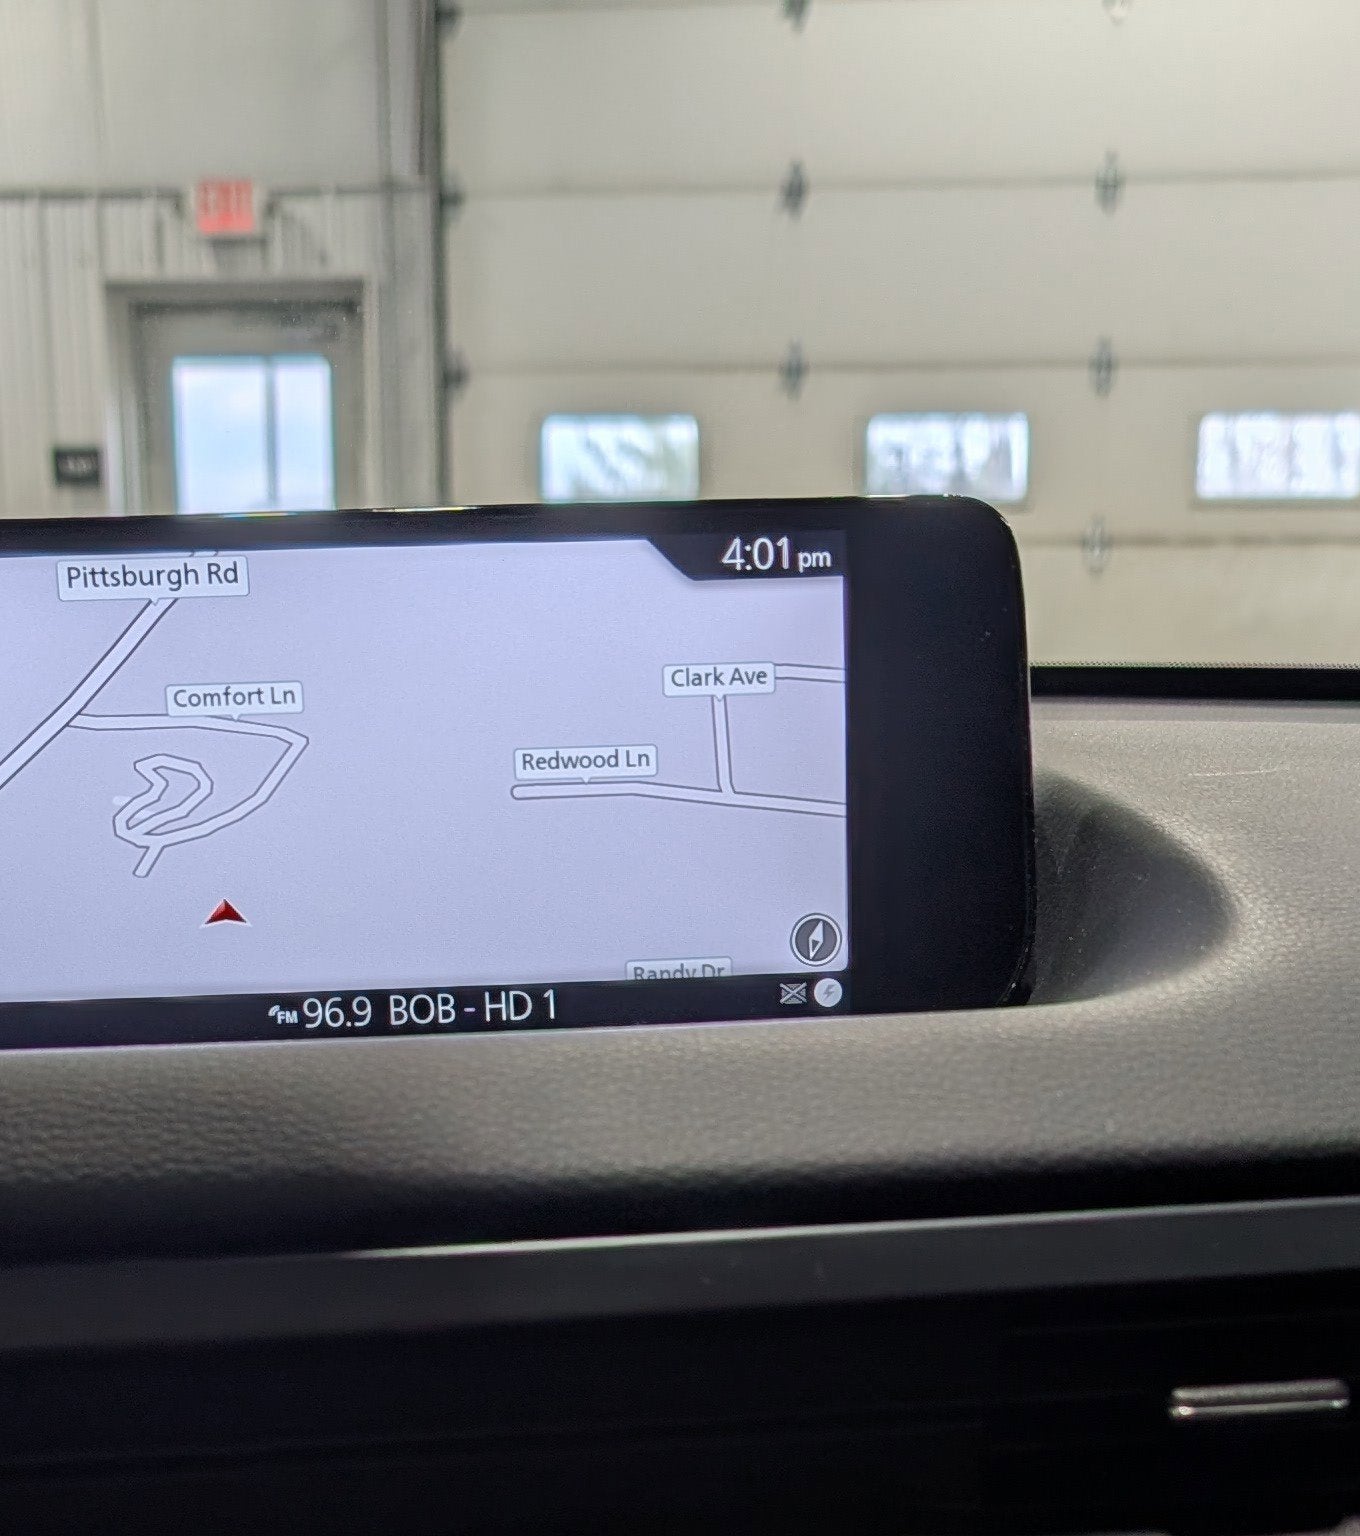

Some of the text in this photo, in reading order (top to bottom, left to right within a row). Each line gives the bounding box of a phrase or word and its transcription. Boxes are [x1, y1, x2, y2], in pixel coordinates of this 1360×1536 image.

[721, 537, 832, 573] 4:01 pm
[65, 562, 239, 592] Pittsburgh Rd
[670, 667, 768, 687] Clark Ave
[173, 686, 296, 709] Comfort Ln
[521, 748, 650, 771] Redwood Ln
[702, 963, 725, 977] Dr
[277, 1010, 297, 1024] FM
[304, 997, 372, 1029] 96.9
[389, 995, 456, 1024] BOB
[484, 991, 532, 1022] HD
[543, 988, 556, 1019] 1
